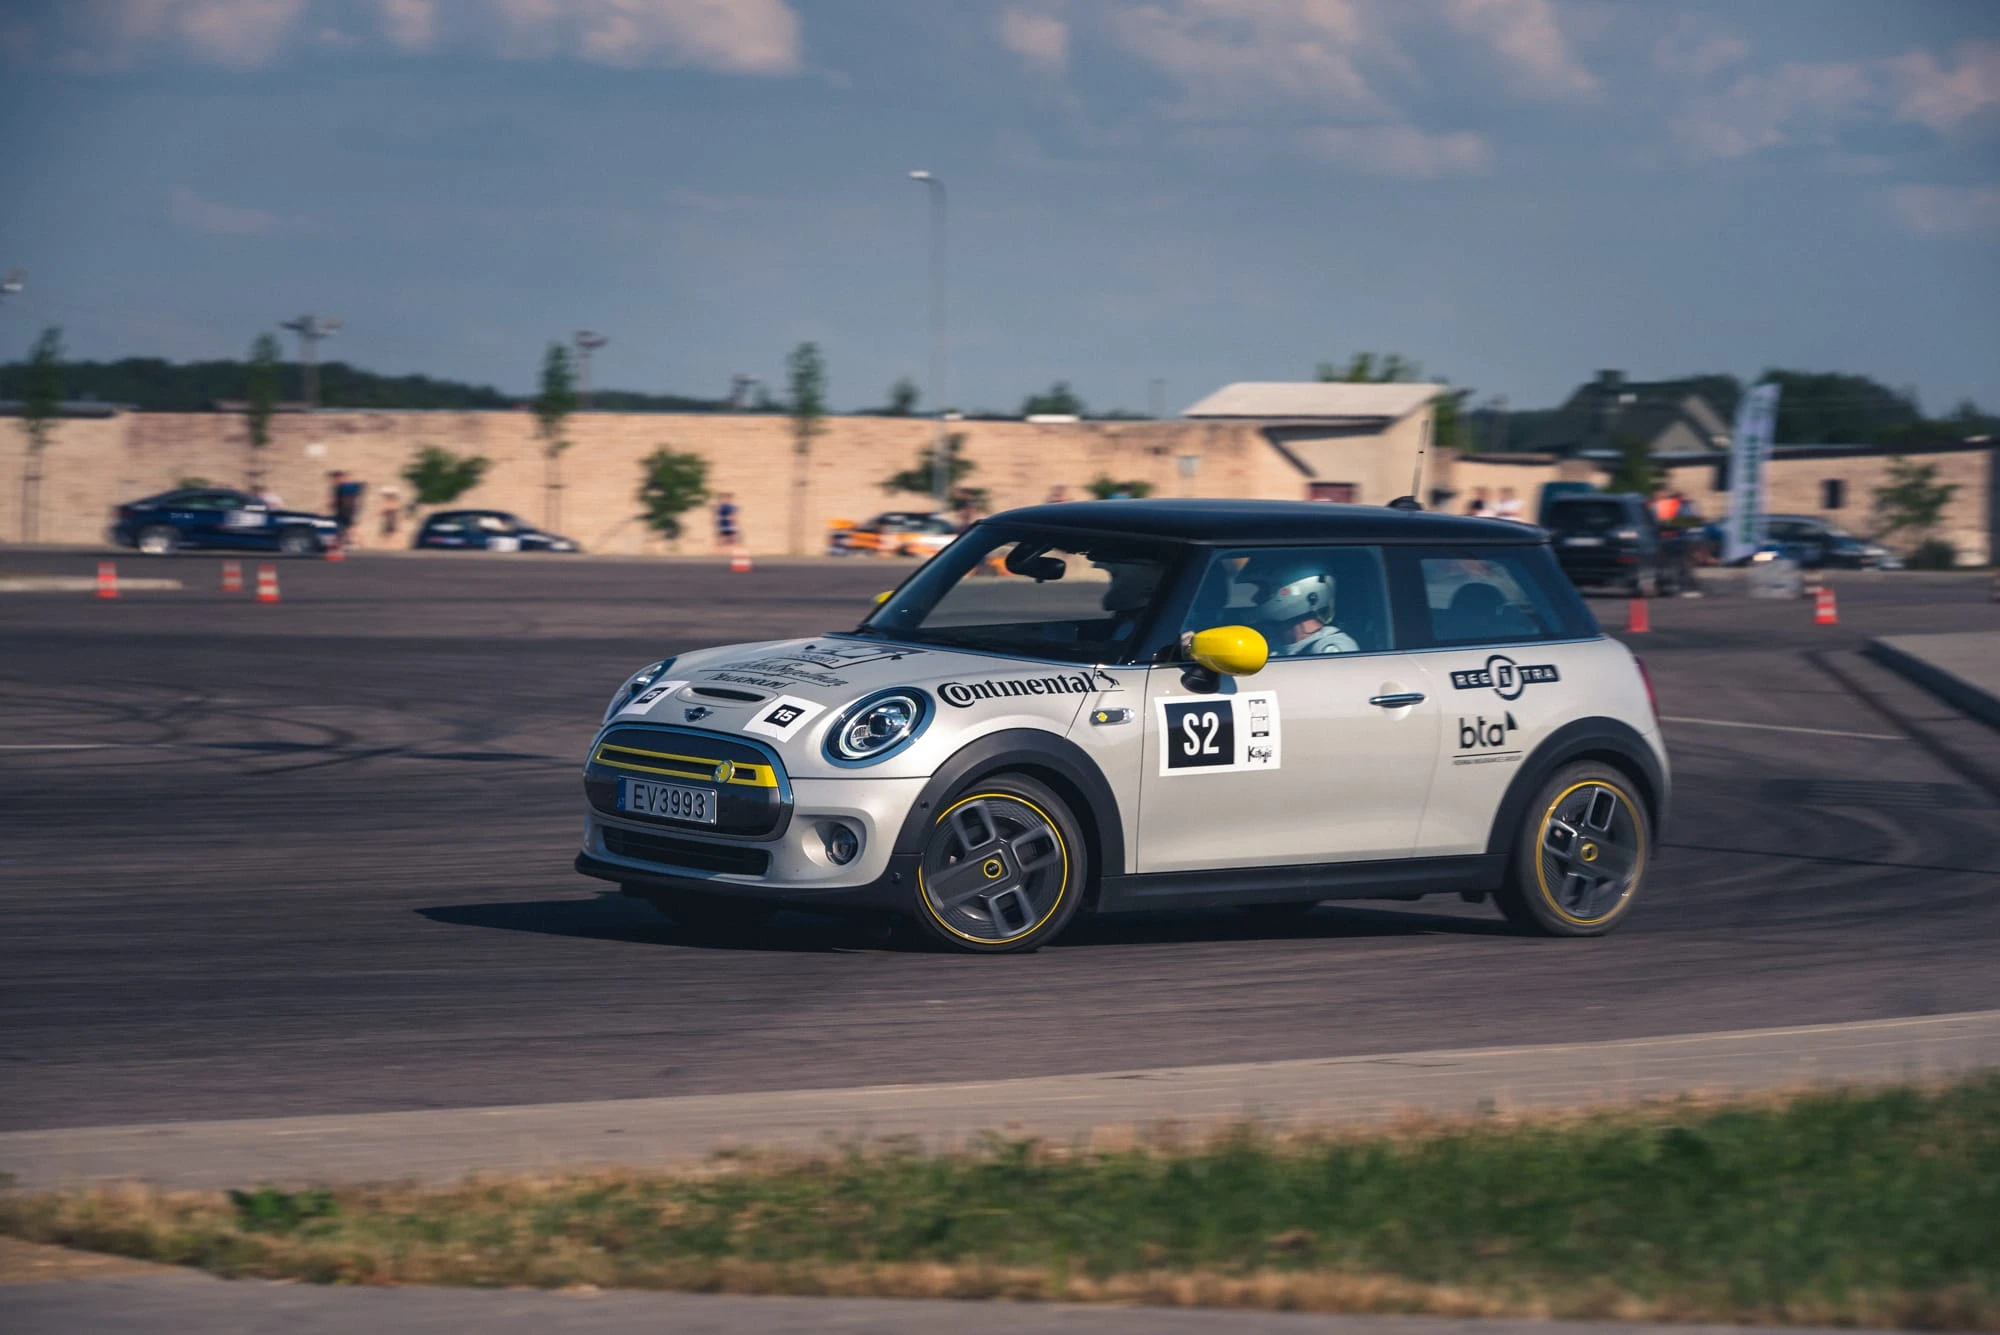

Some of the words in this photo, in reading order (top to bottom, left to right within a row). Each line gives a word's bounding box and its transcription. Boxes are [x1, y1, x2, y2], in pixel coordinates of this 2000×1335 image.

[937, 671, 1099, 708] Continental
[774, 709, 797, 722] 15
[1458, 716, 1505, 749] bta
[1182, 711, 1220, 756] S2
[633, 783, 706, 818] EV3993
